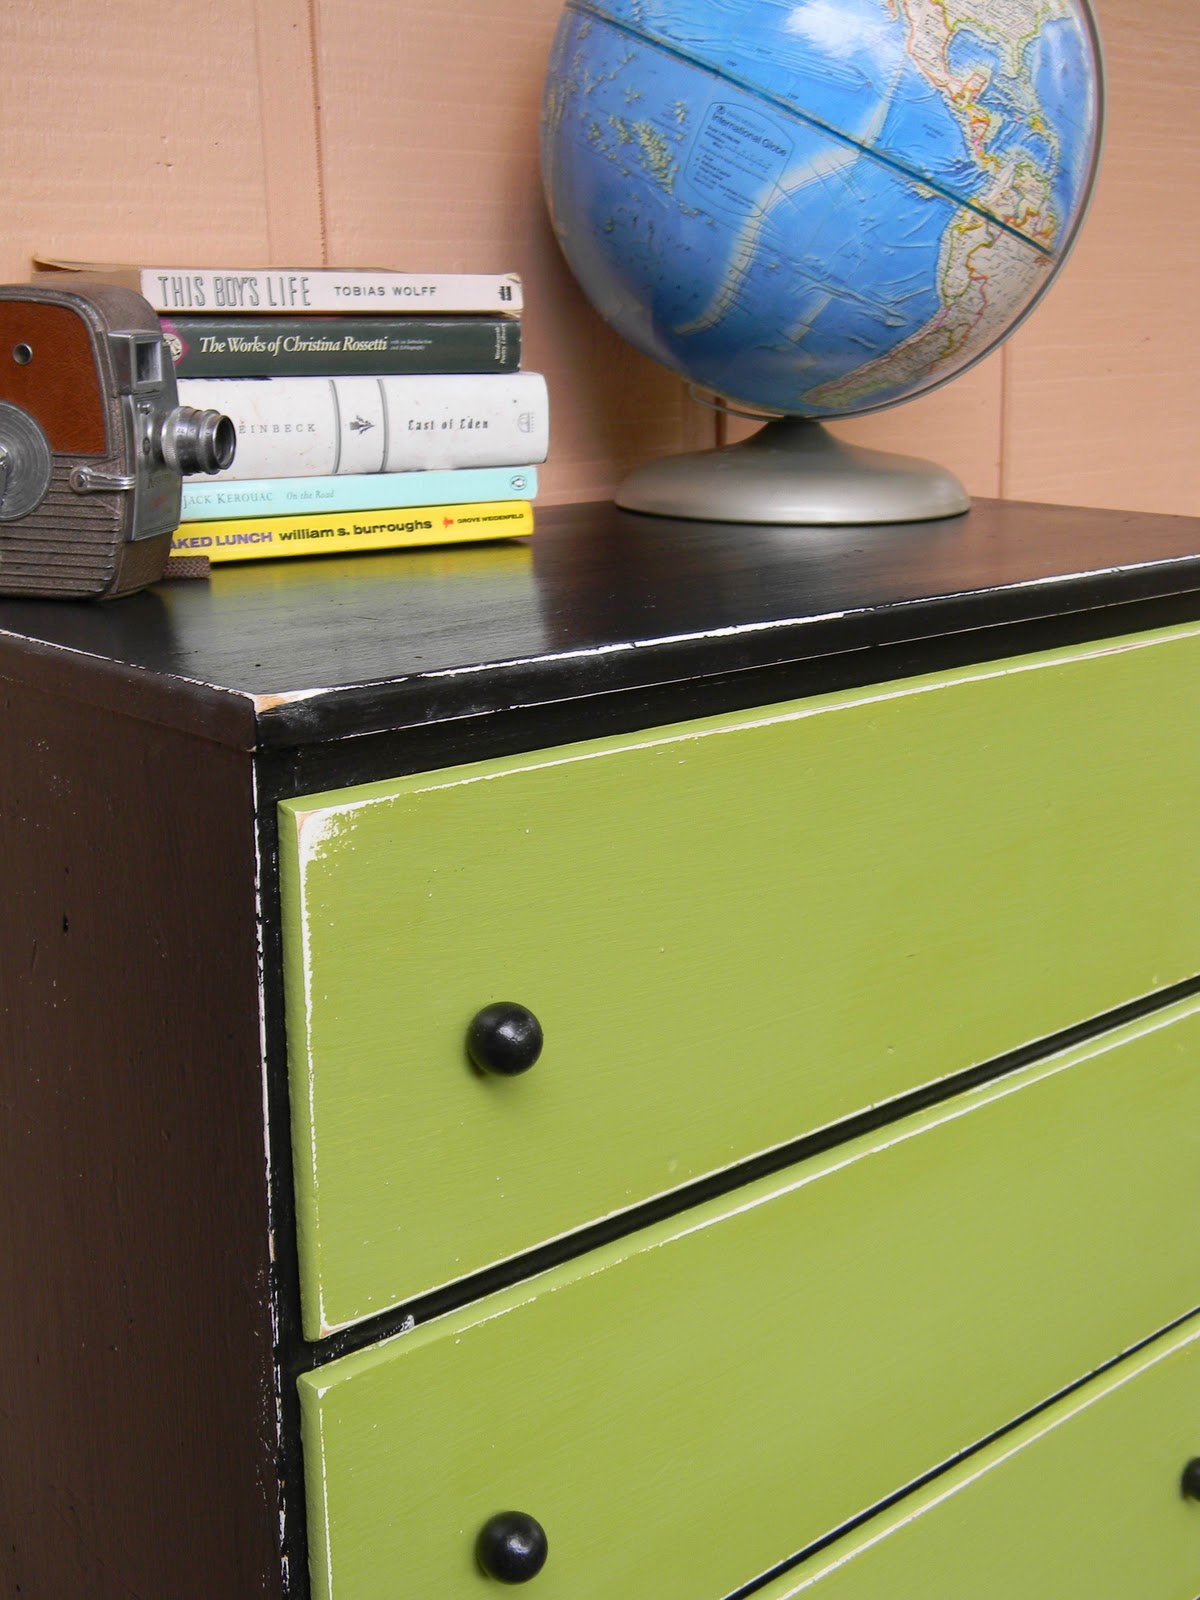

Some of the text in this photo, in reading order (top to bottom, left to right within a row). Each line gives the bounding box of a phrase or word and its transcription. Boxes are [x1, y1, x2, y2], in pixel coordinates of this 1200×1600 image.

[761, 138, 787, 157] Globe
[158, 276, 311, 306] THIS BOY'S LIFE
[334, 286, 437, 296] TOBIAS WOLFF
[200, 335, 388, 357] The Works of Christina Rossetti
[408, 418, 489, 430] East of Eden
[183, 494, 212, 509] JACK
[217, 492, 273, 504] KEROUAC
[286, 490, 335, 500] On the Road
[279, 519, 433, 541] william s. burroughs
[216, 532, 273, 546] LUNCH
